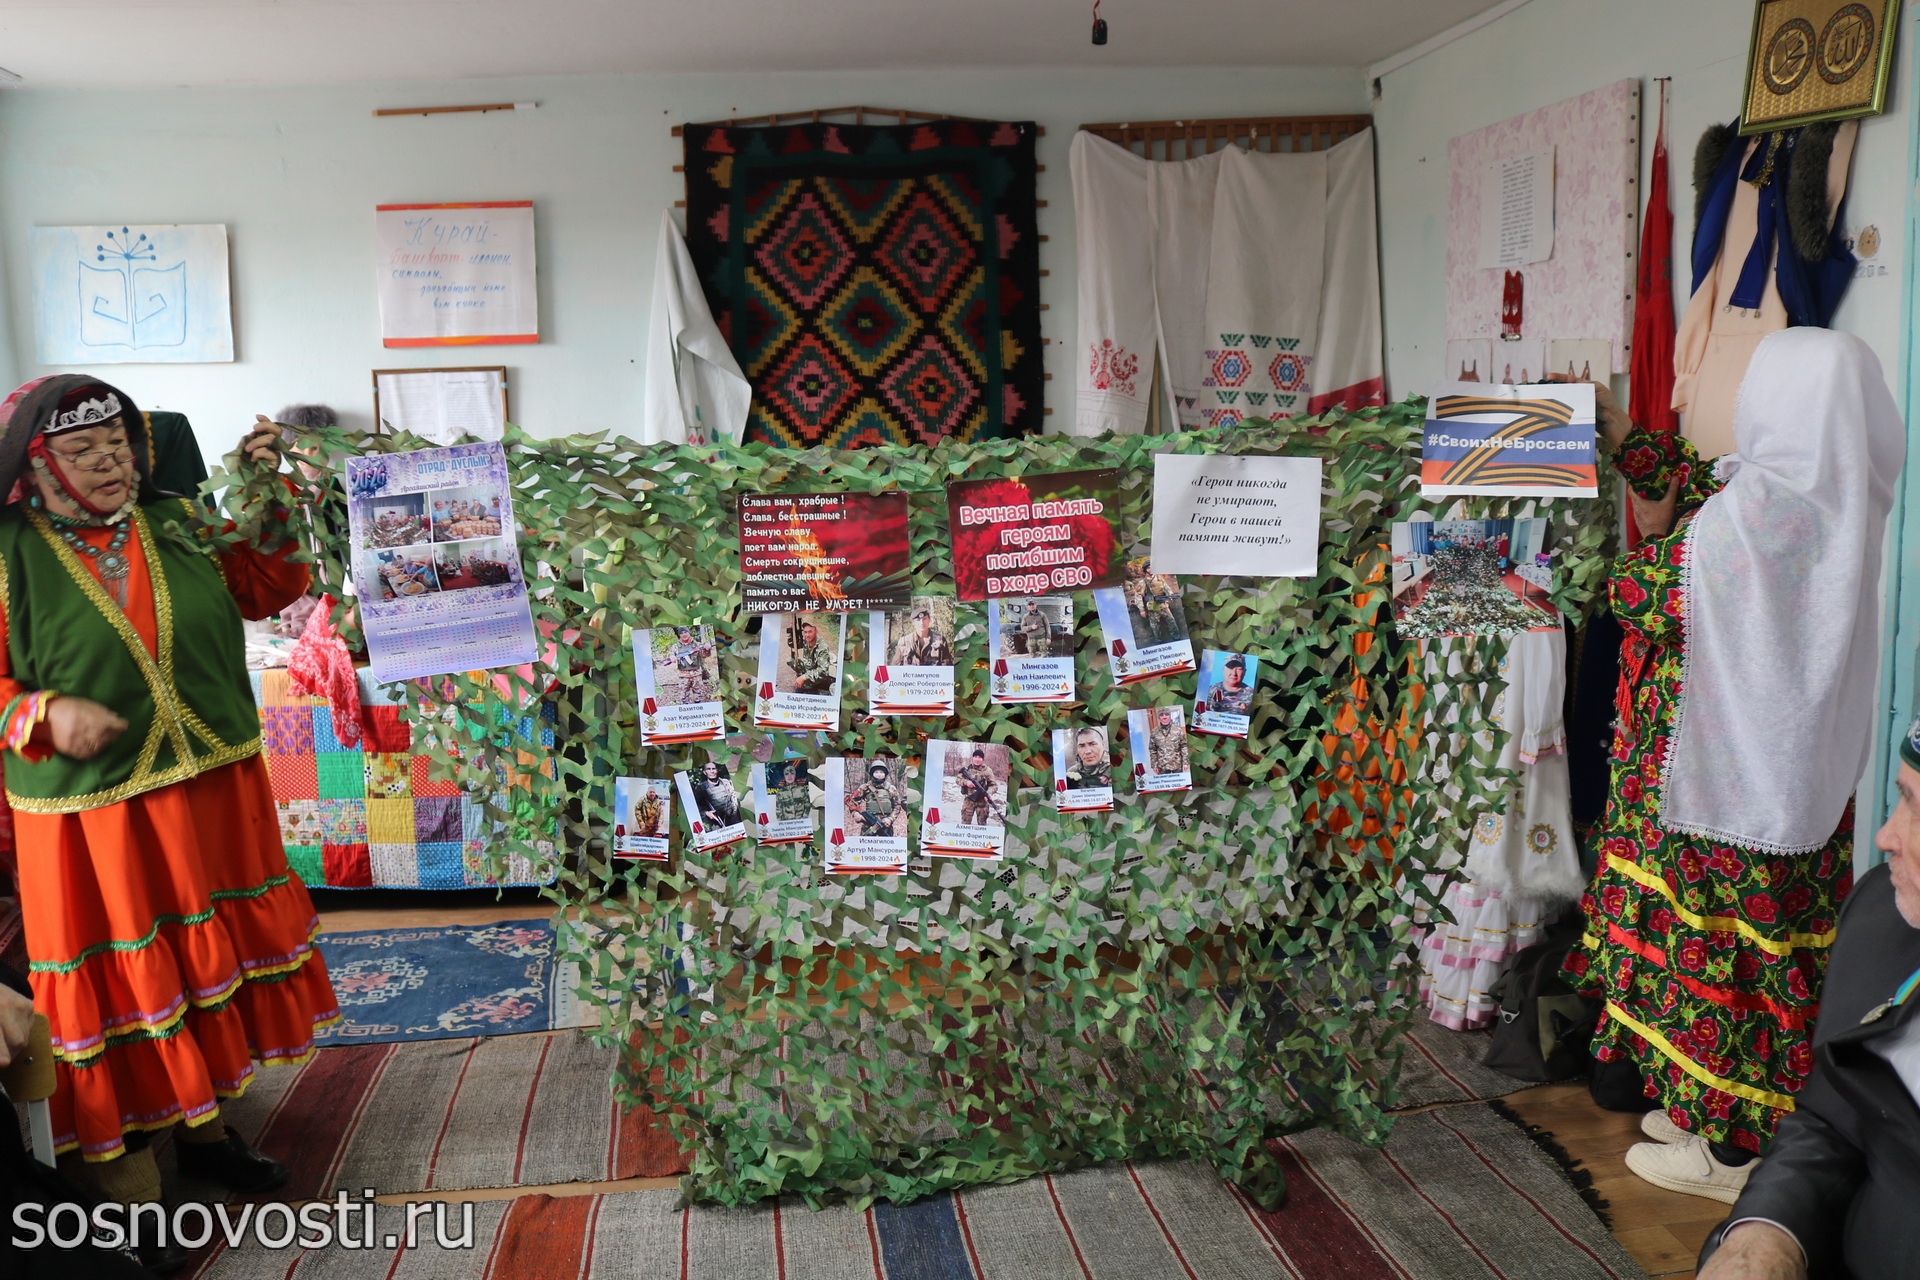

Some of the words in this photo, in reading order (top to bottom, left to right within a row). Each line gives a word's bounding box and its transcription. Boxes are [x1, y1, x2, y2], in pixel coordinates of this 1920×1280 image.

[1428, 434, 1590, 452] #СвоихНеБросаем
[418, 461, 446, 474] ОТРЯД
[440, 480, 460, 490] район
[1191, 477, 1232, 491] «Герои
[1236, 478, 1288, 490] никогда
[743, 496, 771, 507] Слава
[774, 498, 796, 506] вам,
[799, 497, 839, 507] храбрые
[1196, 496, 1210, 505] не
[1214, 496, 1278, 509] умирают,
[743, 513, 775, 522] Слава,
[778, 512, 840, 521] бесстрашные
[959, 505, 1029, 526] Вечная
[1032, 498, 1103, 522] память
[1189, 512, 1226, 528] Герои
[1230, 516, 1237, 525] в
[1240, 514, 1282, 527] нашей
[744, 527, 782, 538] Вечную
[784, 528, 810, 538] славу
[1001, 524, 1070, 547] героям
[1178, 531, 1228, 544] памяти
[1232, 534, 1292, 546] живут!»
[745, 544, 765, 552] поет
[768, 543, 786, 551] вам
[745, 557, 780, 567] Смерть
[783, 556, 849, 566] сокрушившие,
[986, 546, 1084, 571] погибшим
[746, 572, 794, 582] доблестно
[796, 572, 834, 581] павшие,
[988, 579, 1001, 594] в
[1002, 573, 1050, 594] ходе
[1051, 566, 1092, 588] СВО
[747, 588, 779, 597] память
[782, 588, 787, 596] о
[790, 588, 805, 596] вас
[748, 601, 799, 612] НИКОГДА
[805, 601, 820, 610] НЕ
[826, 599, 863, 610] УМРЕТ
[1143, 646, 1172, 655] Мингазов
[1133, 657, 1159, 666] Мударис
[1147, 661, 1176, 671] 1978-2024
[1022, 683, 1059, 691] 1996-2024
[787, 695, 826, 703] Бадретдинов
[798, 704, 838, 712] Исрафилович
